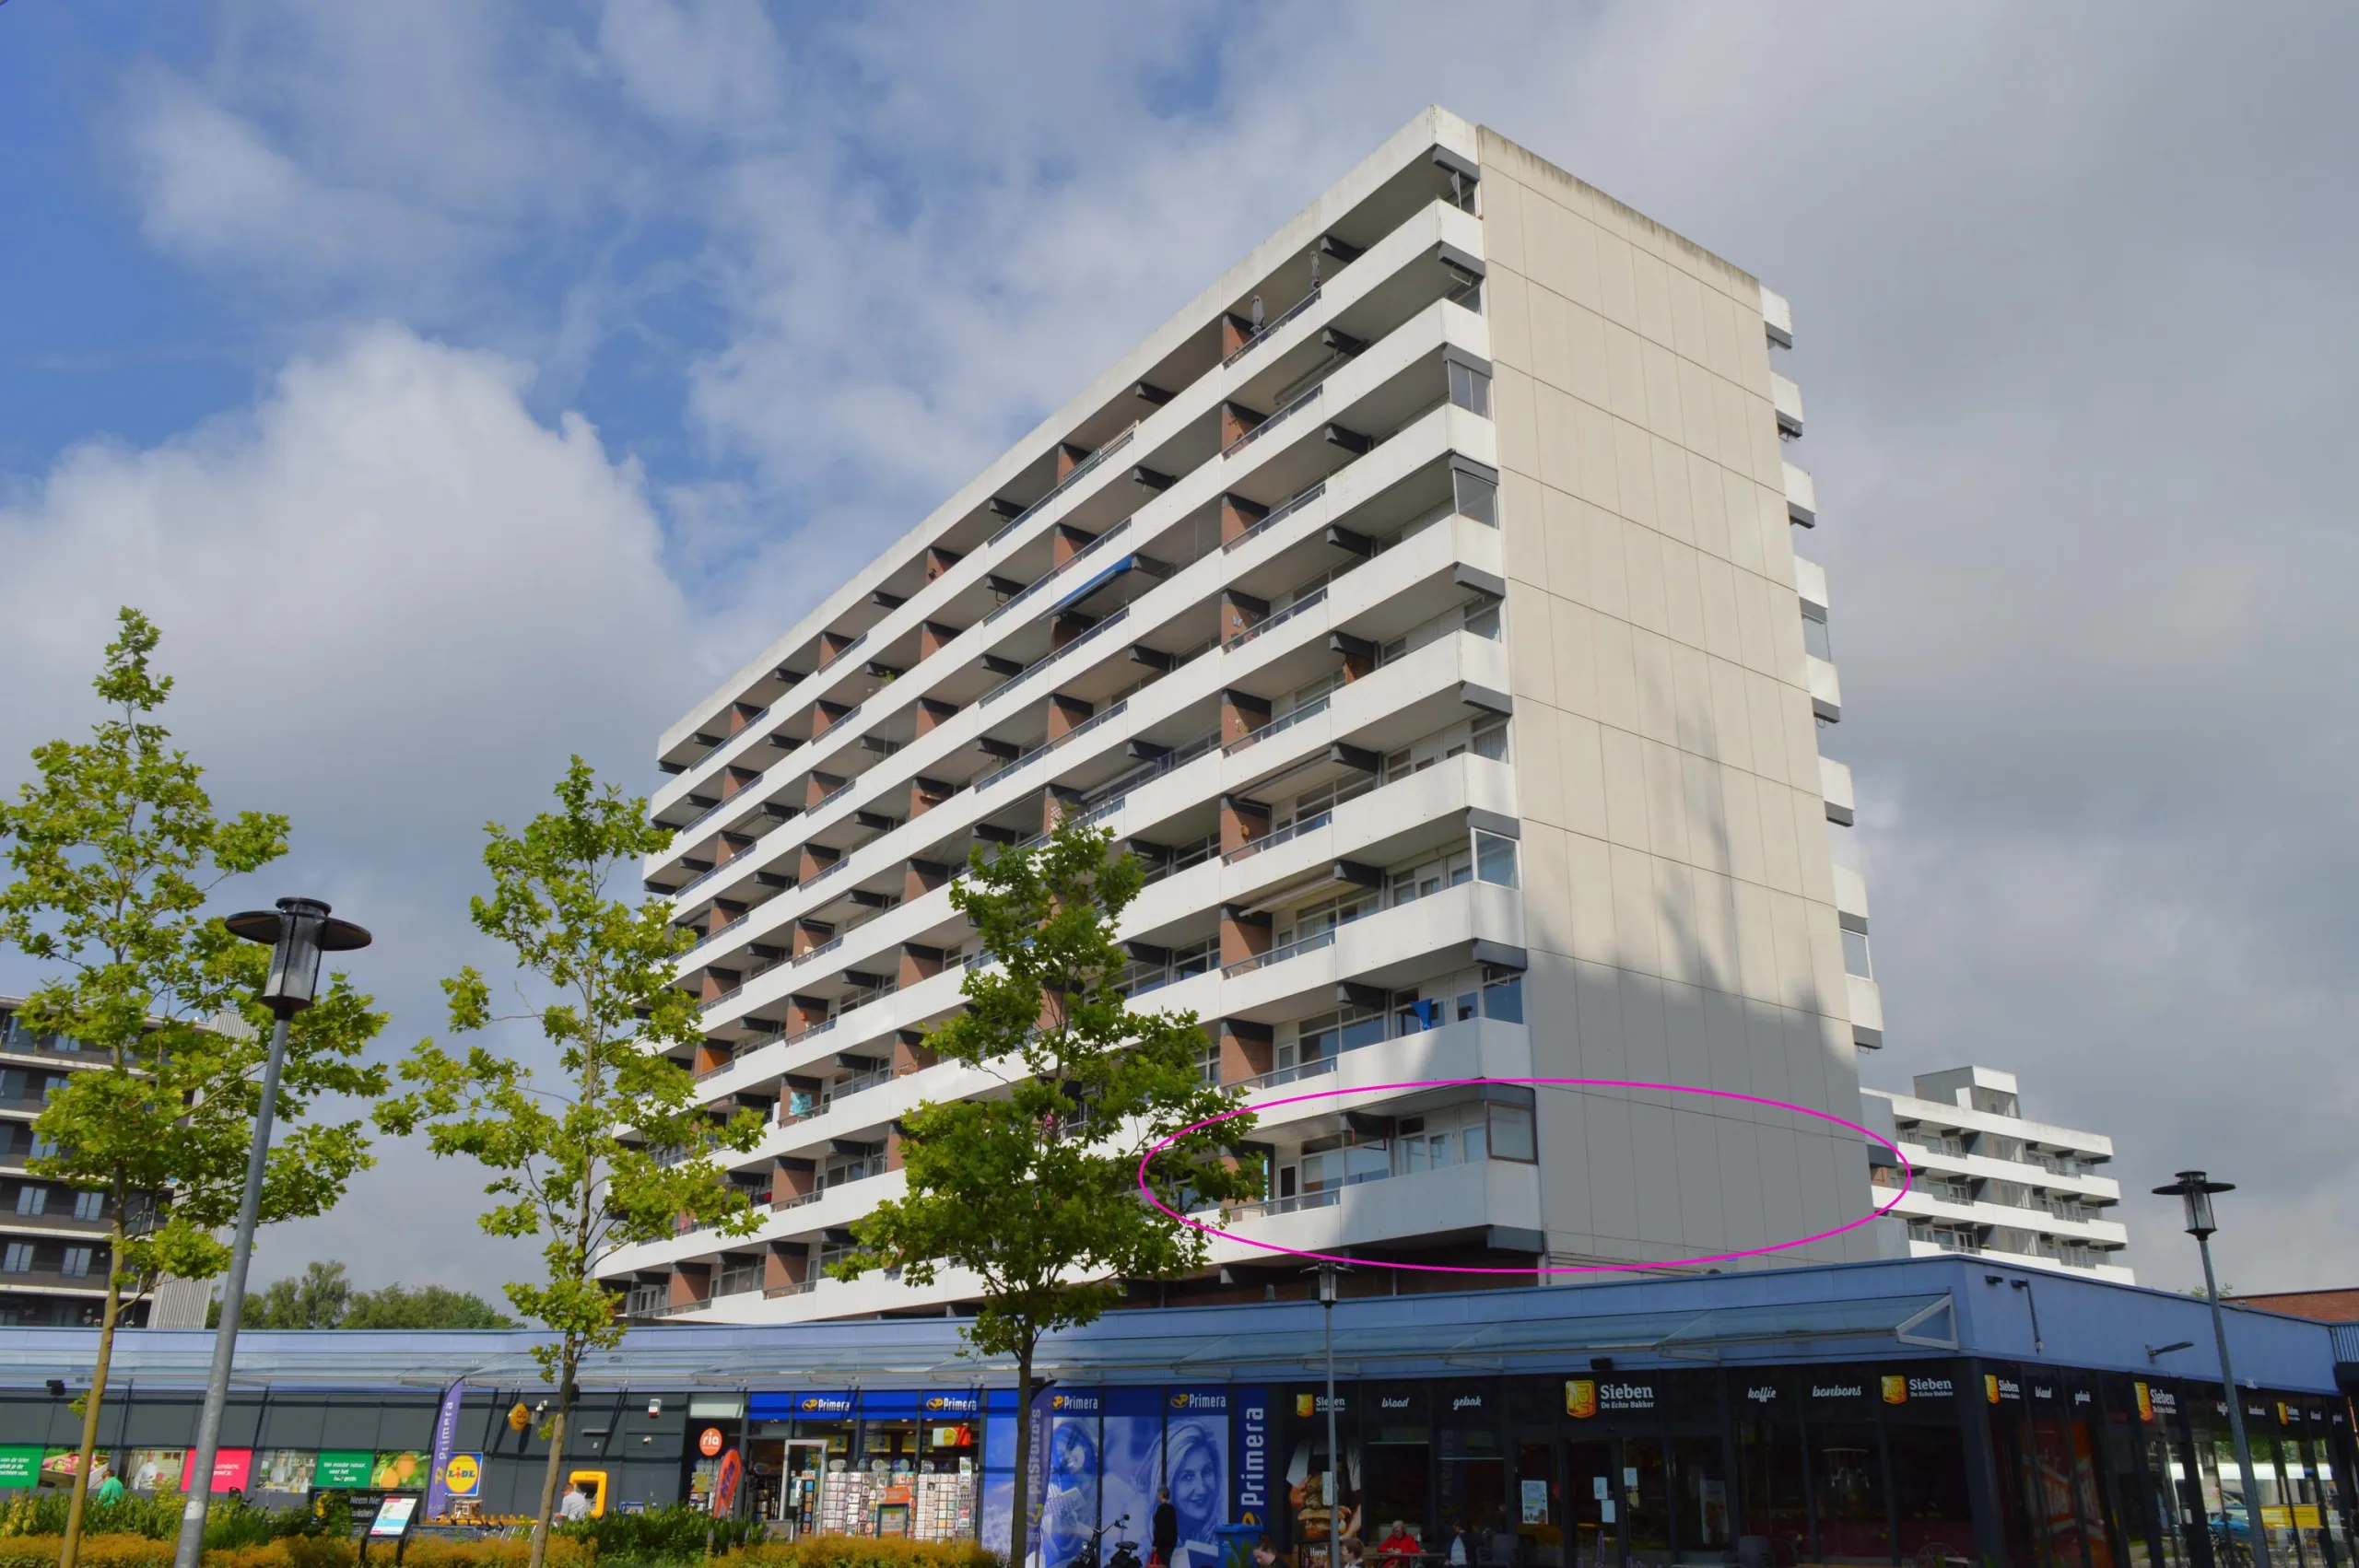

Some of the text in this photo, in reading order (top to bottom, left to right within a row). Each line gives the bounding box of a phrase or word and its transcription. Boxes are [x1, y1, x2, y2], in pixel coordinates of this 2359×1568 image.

[1909, 1377, 1953, 1390] Sieben
[1600, 1383, 1654, 1399] Sieben
[1747, 1387, 1777, 1403] koffie
[1813, 1385, 1862, 1397] bonbons
[2150, 1387, 2176, 1405] Sieben
[817, 1398, 851, 1411] Primera
[943, 1398, 977, 1411] Primera
[1064, 1395, 1098, 1410] Primera
[1189, 1393, 1226, 1408] Primera
[1316, 1396, 1345, 1406] Sieen
[1381, 1397, 1410, 1408] brood
[1453, 1396, 1482, 1410] gebak
[440, 1401, 453, 1460] Primera
[702, 1432, 720, 1445] ria
[1027, 1409, 1041, 1495] PASFOTO'S
[1240, 1408, 1264, 1506] Primera
